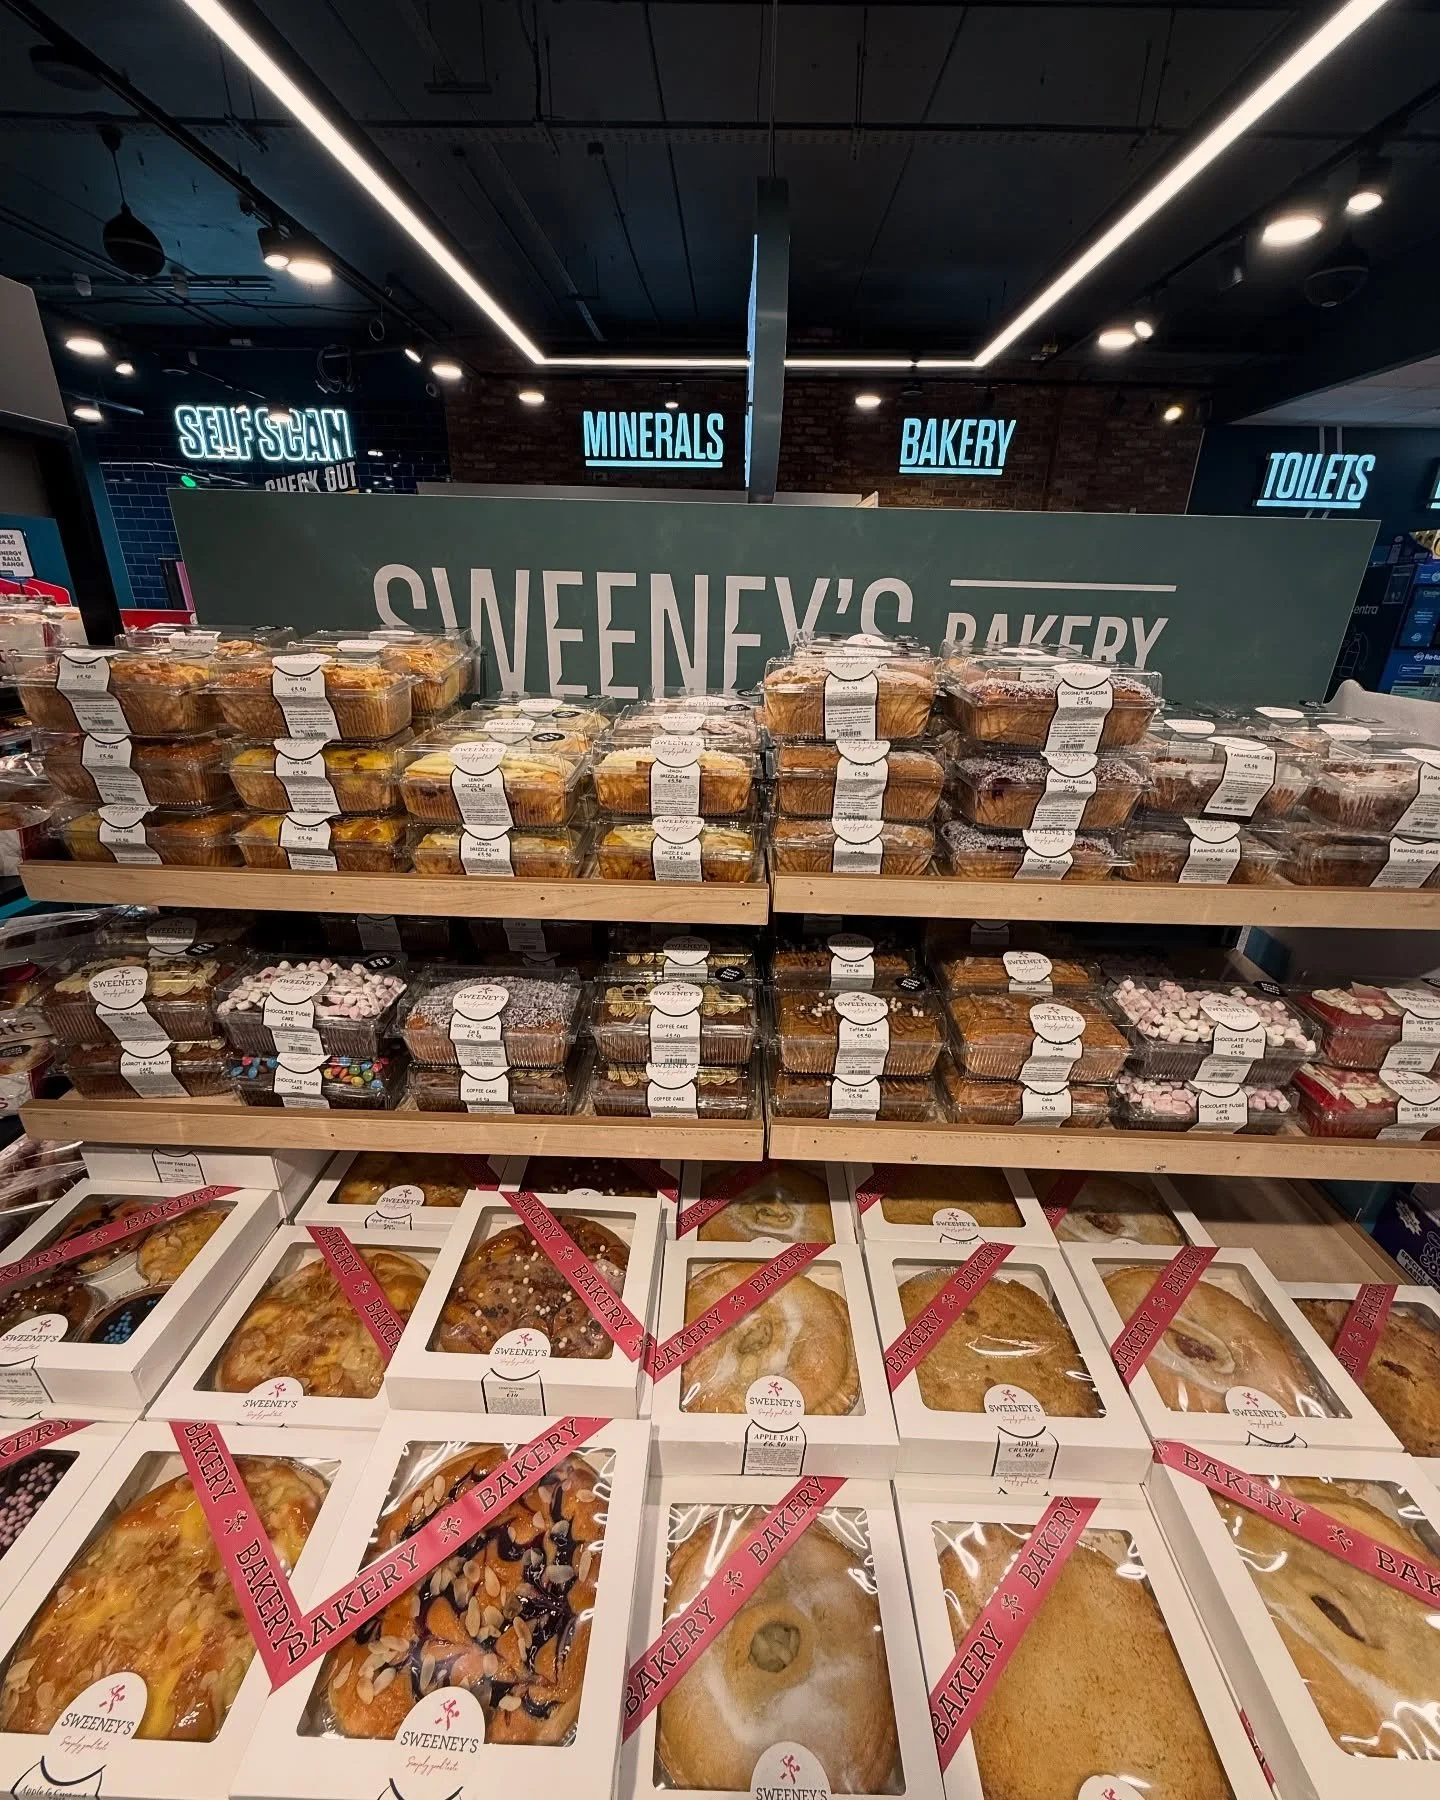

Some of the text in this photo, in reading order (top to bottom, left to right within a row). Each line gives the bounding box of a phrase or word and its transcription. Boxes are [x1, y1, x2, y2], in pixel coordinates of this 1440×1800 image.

[175, 405, 355, 462] SELF SCAN
[583, 411, 724, 460] MINERALS
[901, 418, 1017, 466] BAKERY
[324, 461, 357, 492] OUT
[1263, 453, 1376, 501] TOILETS
[1352, 605, 1379, 615] entra
[93, 979, 143, 988] SWEENEY'S
[458, 993, 505, 1001] SWEENEY'S
[265, 1008, 295, 1016] CHOCOLATE
[1033, 1013, 1082, 1022] SWEENEY'S
[276, 1077, 303, 1085] CHOCOLATE
[381, 1196, 421, 1205] SWEENEY'S
[0, 1185, 221, 1282] KERY BAKERY
[317, 1226, 362, 1277] BAKERY
[510, 1191, 633, 1332] BAKERY BAKERY
[652, 1243, 813, 1374] BAKERY BAKERY
[884, 1310, 942, 1374] BAKERY
[955, 1242, 1004, 1292] BAKERY
[1111, 1246, 1207, 1376] BAKERY BAKERY
[495, 1348, 548, 1357] SWEENEY'S
[242, 1400, 298, 1408] SWEENEY'S
[749, 1397, 801, 1407] SWEENEY'S
[989, 1404, 1041, 1412] SWEENEY'S
[1232, 1408, 1287, 1418] SWEENEY'S
[0, 1420, 73, 1459] KERY
[186, 1422, 304, 1651] BAKERY BAKERY
[1182, 1450, 1440, 1597] BAKERY BAK
[285, 1418, 581, 1667] BAKERY BAKERY
[623, 1597, 716, 1718] BAKERY
[748, 1475, 826, 1567] BAKERY
[932, 1620, 1005, 1746] BAKERY
[1018, 1496, 1083, 1590] BAKERY
[61, 1712, 135, 1735] SWEENEY'S
[400, 1730, 479, 1754] SWEENEY'S
[755, 1787, 828, 1800] SWEENEY'S
